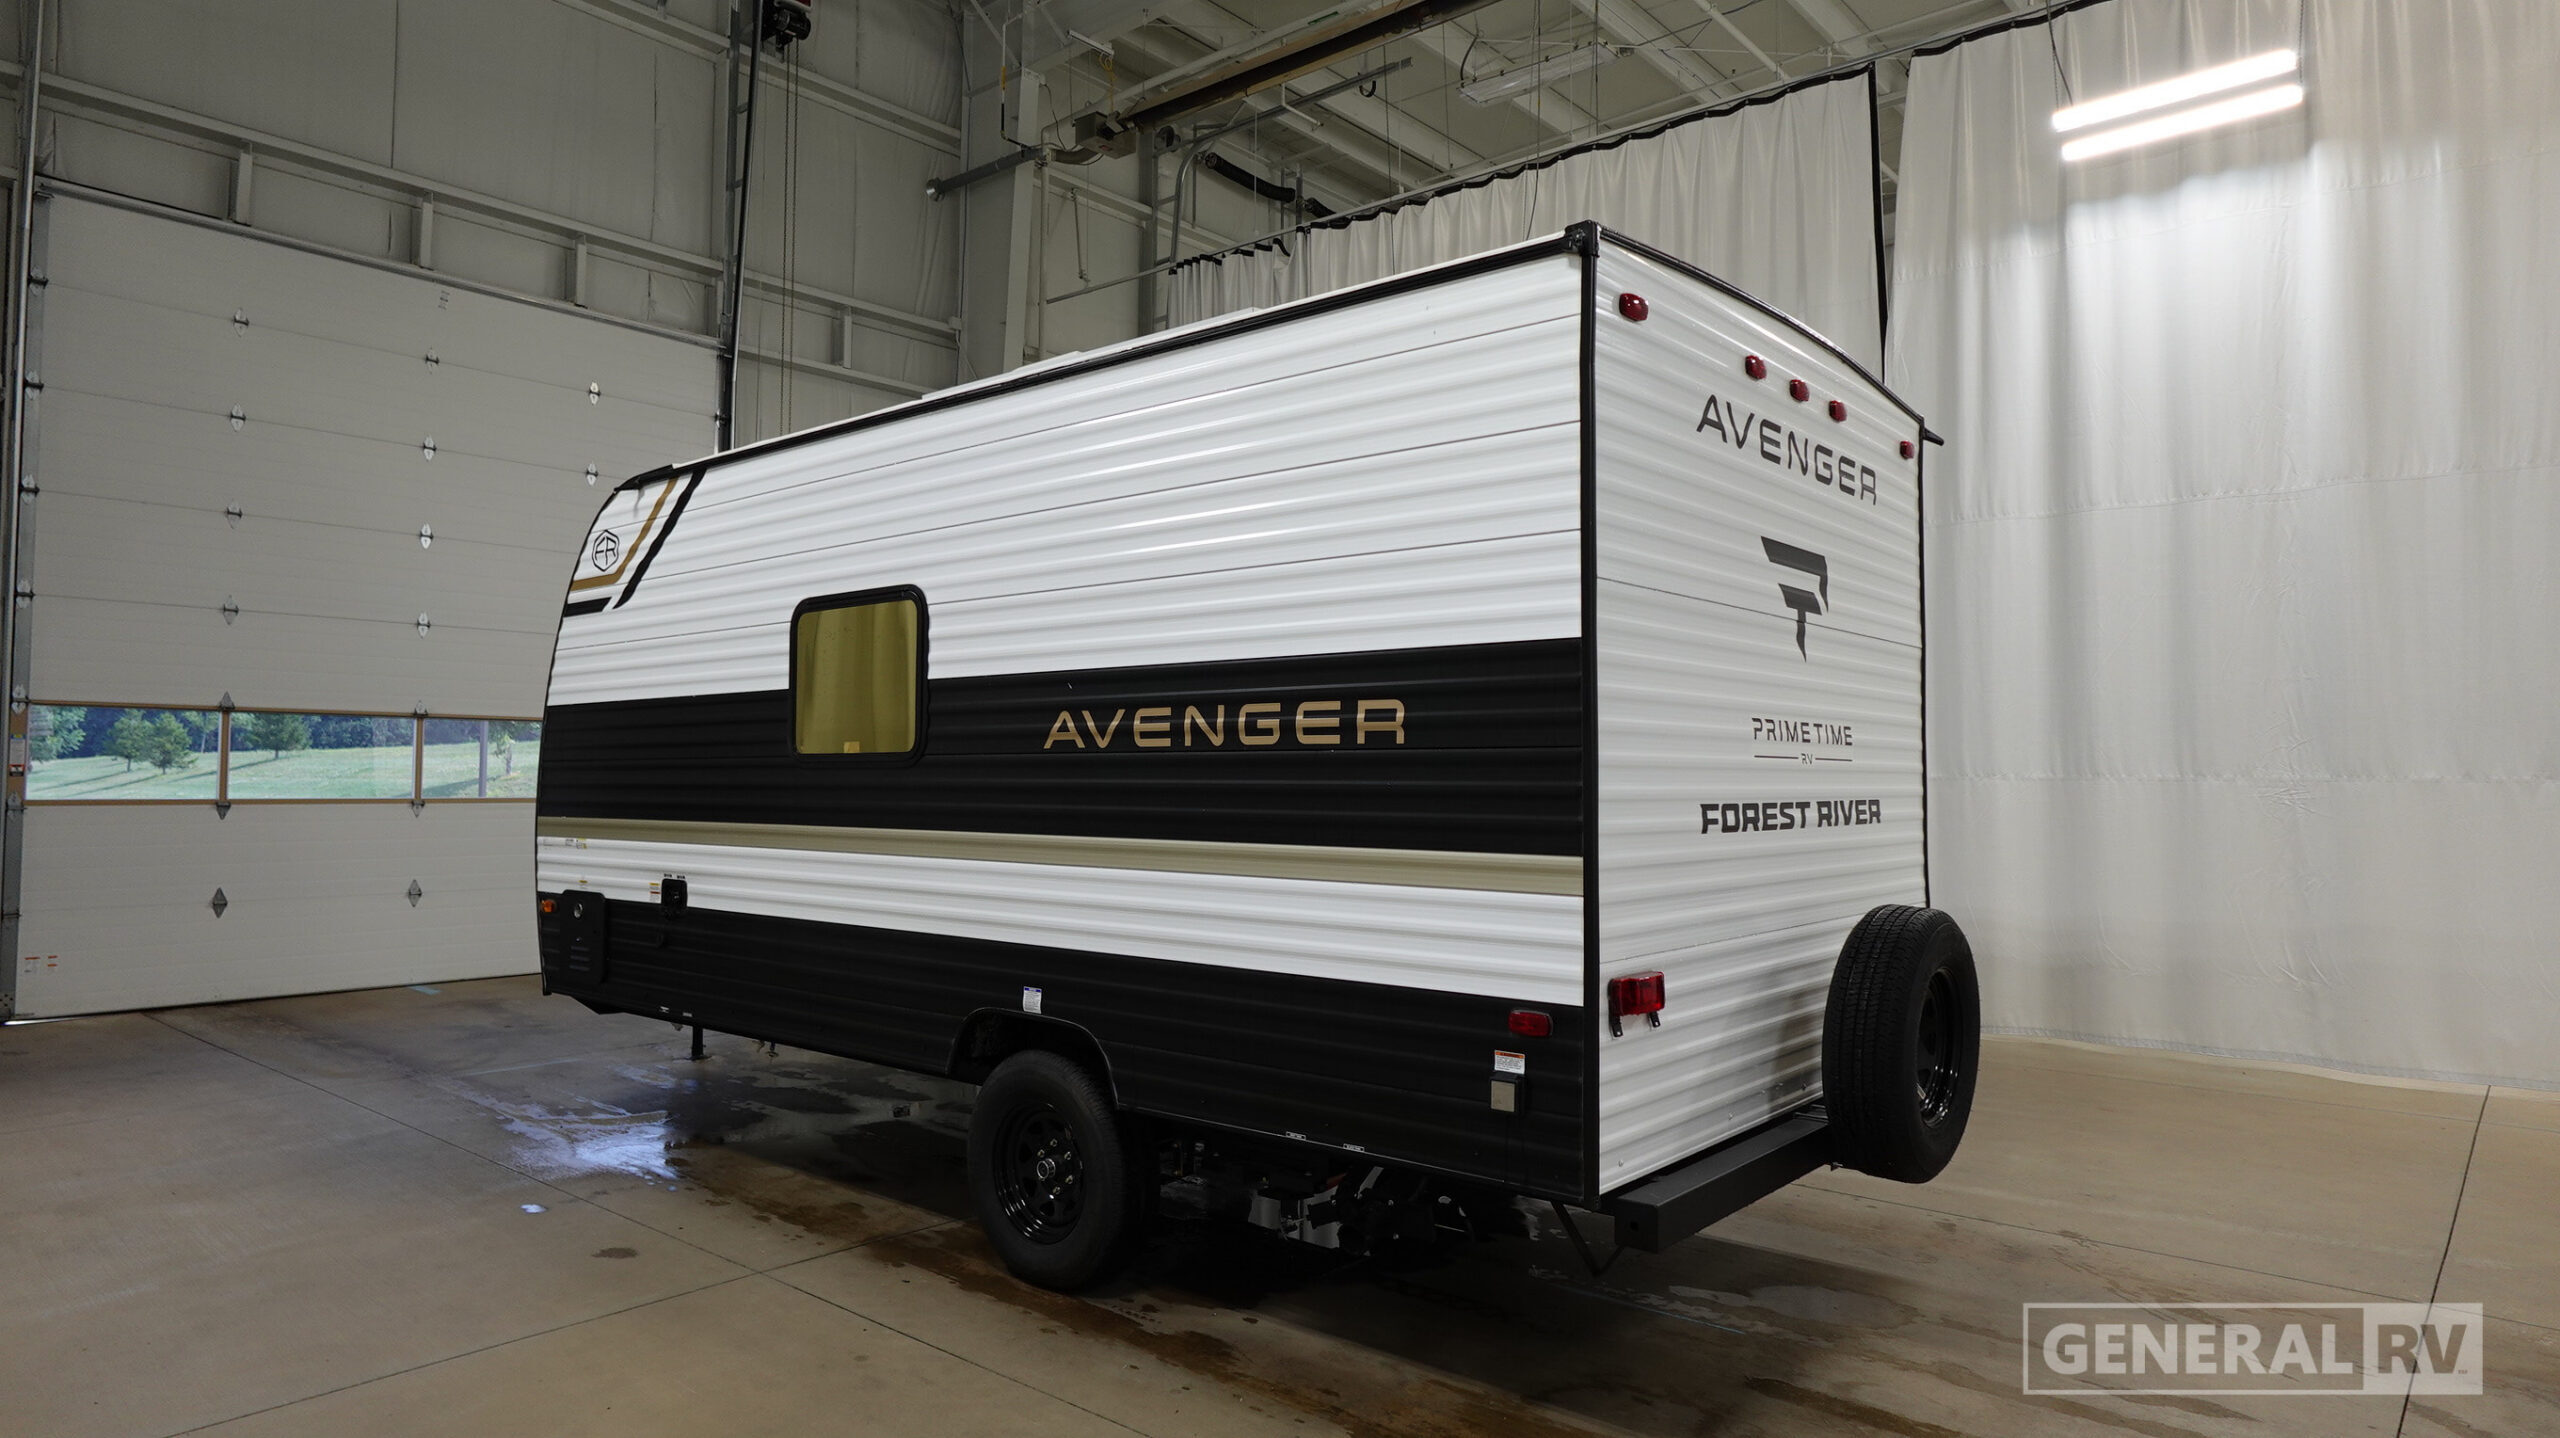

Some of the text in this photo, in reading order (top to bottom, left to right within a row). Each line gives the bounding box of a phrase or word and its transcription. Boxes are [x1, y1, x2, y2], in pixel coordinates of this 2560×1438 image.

[1696, 394, 1877, 506] AVENGER
[1043, 699, 1405, 750] AVENGER
[1801, 753, 1814, 765] RV
[1700, 799, 1881, 834] FOREST RIVER
